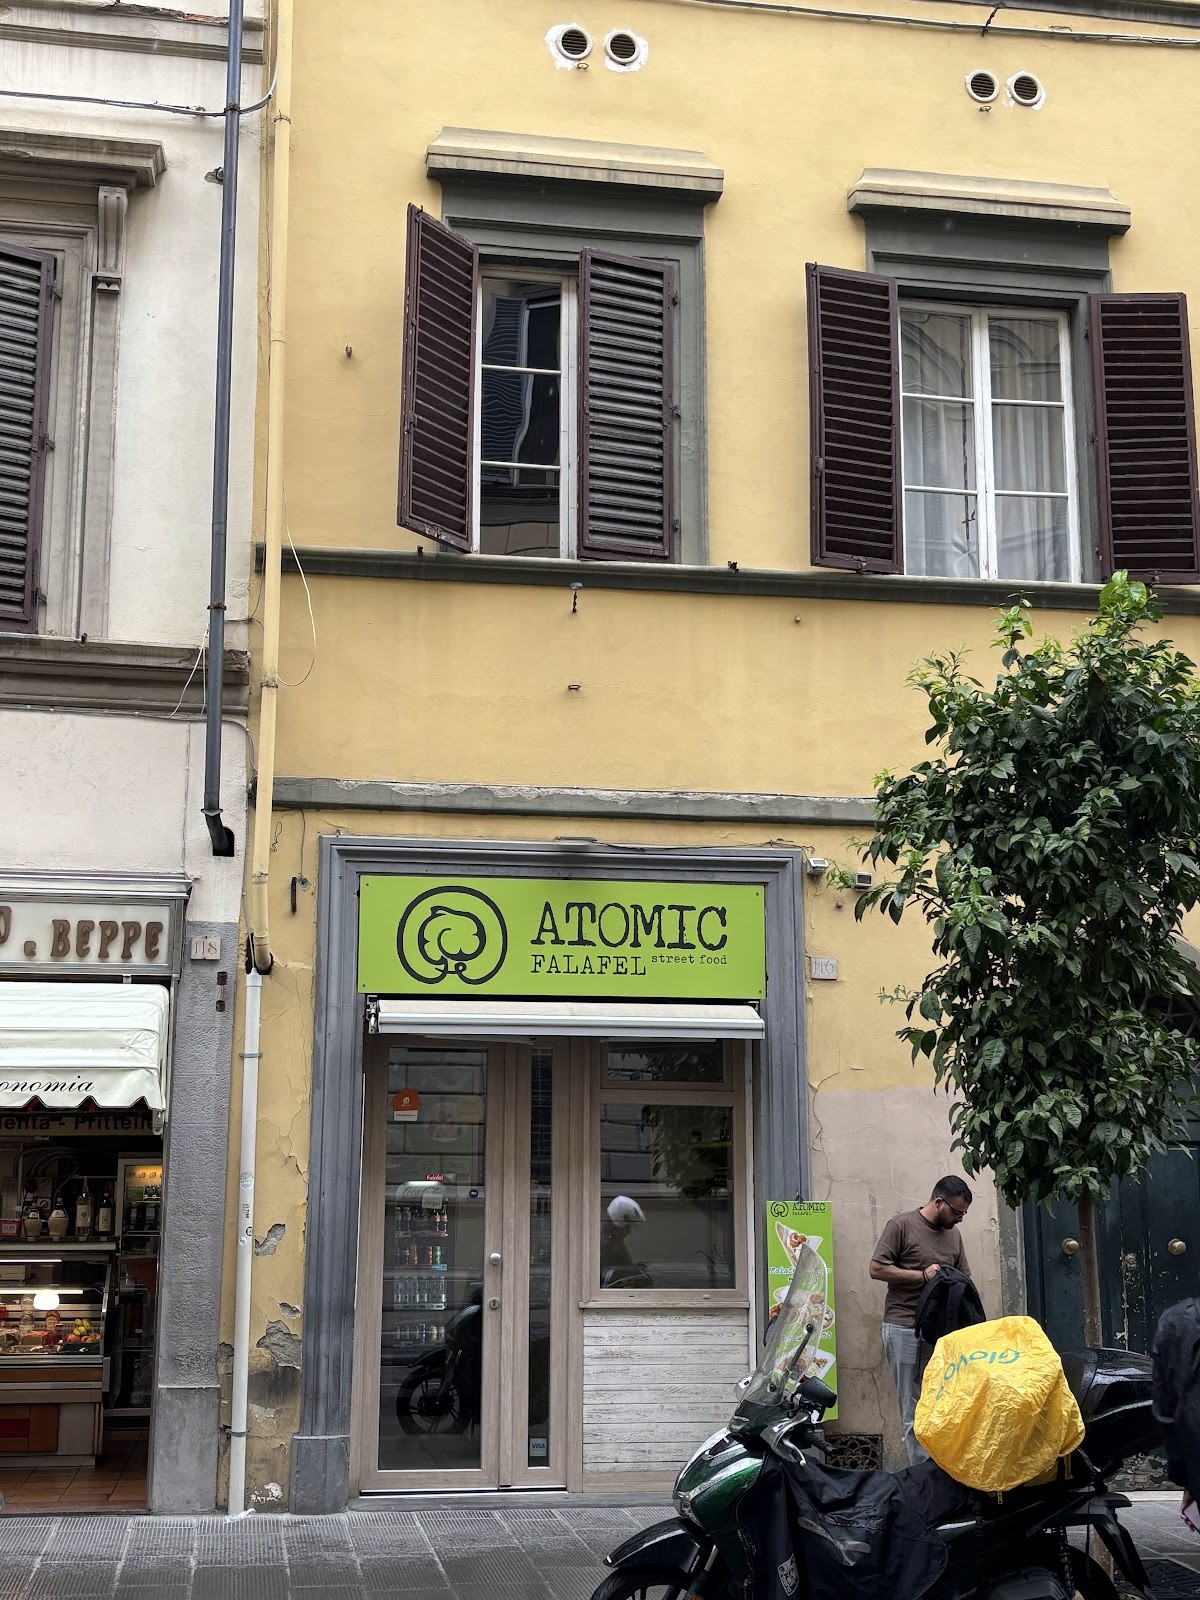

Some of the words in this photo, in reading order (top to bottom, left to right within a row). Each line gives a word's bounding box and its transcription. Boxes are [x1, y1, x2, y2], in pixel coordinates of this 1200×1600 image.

[530, 901, 728, 951] ATOMIC
[50, 919, 164, 959] BEPPE
[195, 941, 217, 954] 118
[530, 954, 647, 976] FALAFEL
[651, 953, 695, 964] street
[699, 954, 728, 965] food
[813, 960, 835, 975] 116
[792, 1202, 826, 1211] ATOMIC
[943, 1348, 1020, 1382] Glovo
